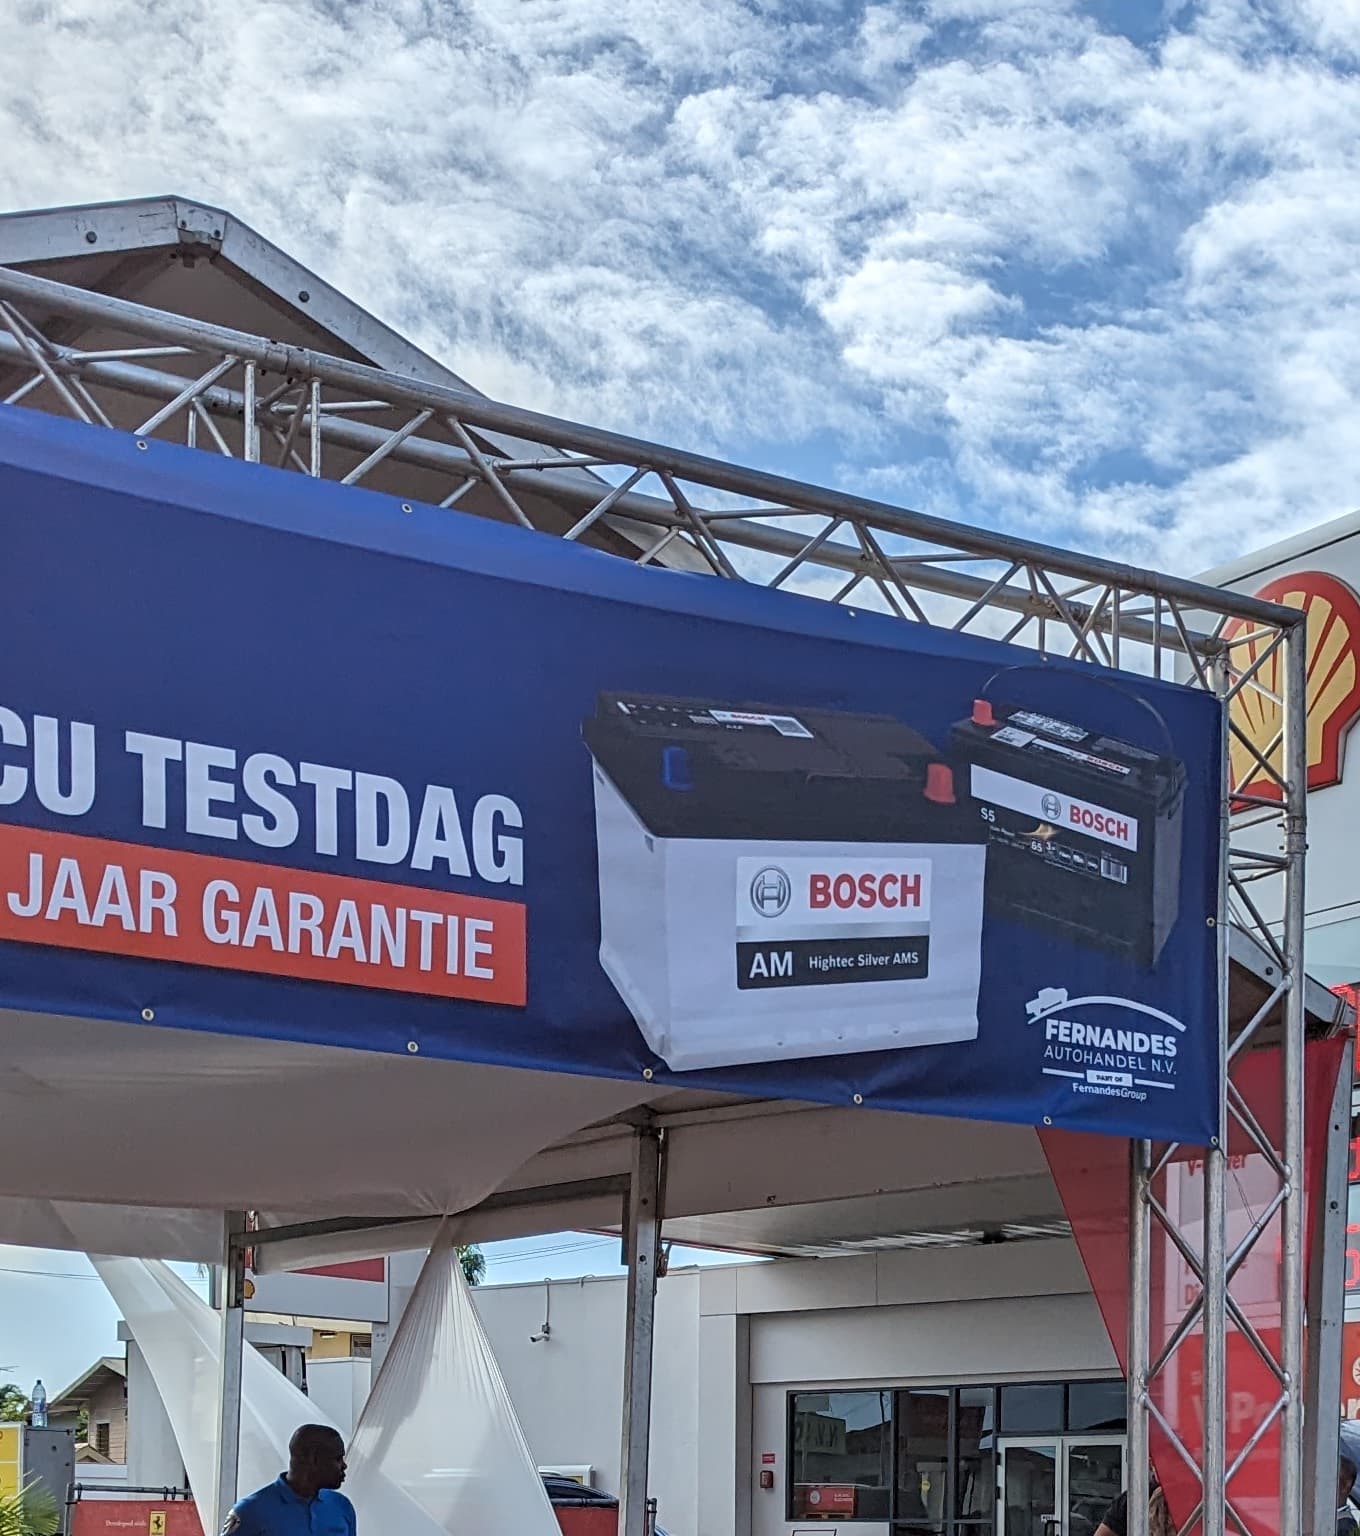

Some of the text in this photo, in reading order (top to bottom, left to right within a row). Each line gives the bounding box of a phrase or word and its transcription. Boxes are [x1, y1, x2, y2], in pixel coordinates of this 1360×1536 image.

[125, 730, 524, 886] TESTDAG
[980, 807, 996, 823] S5
[1070, 804, 1129, 841] BOSCH
[809, 873, 921, 909] BOSCH
[7, 853, 178, 937] JAAR
[201, 878, 495, 981] GARANTIE
[749, 951, 920, 979] AM Hightec Silver AMS
[1045, 1018, 1177, 1058] FERNANDES
[1043, 1045, 1177, 1075] AUTOHANDEL N.V.
[1072, 1082, 1147, 1101] FernandesGroup
